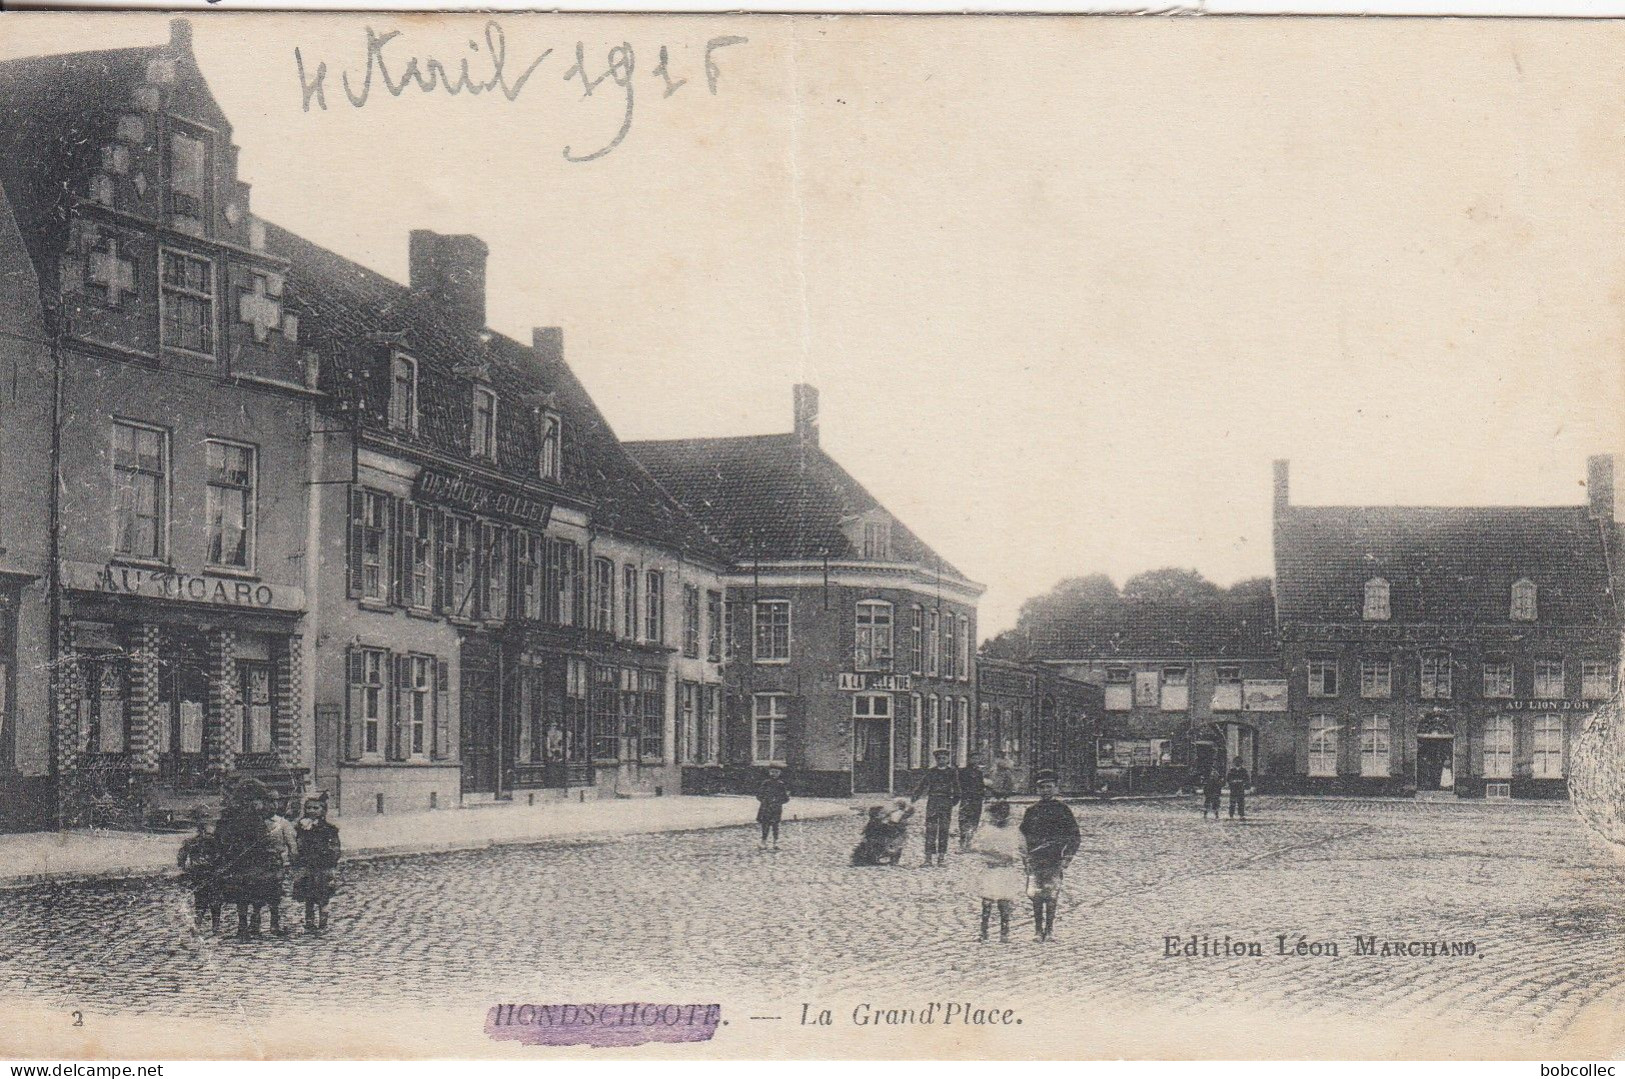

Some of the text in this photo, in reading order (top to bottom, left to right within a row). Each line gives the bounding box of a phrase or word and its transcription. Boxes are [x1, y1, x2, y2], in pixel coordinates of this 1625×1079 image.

[94, 563, 142, 594] AU
[841, 674, 848, 688] A
[851, 674, 863, 689] LA
[1506, 700, 1590, 710] AU LION D'OR
